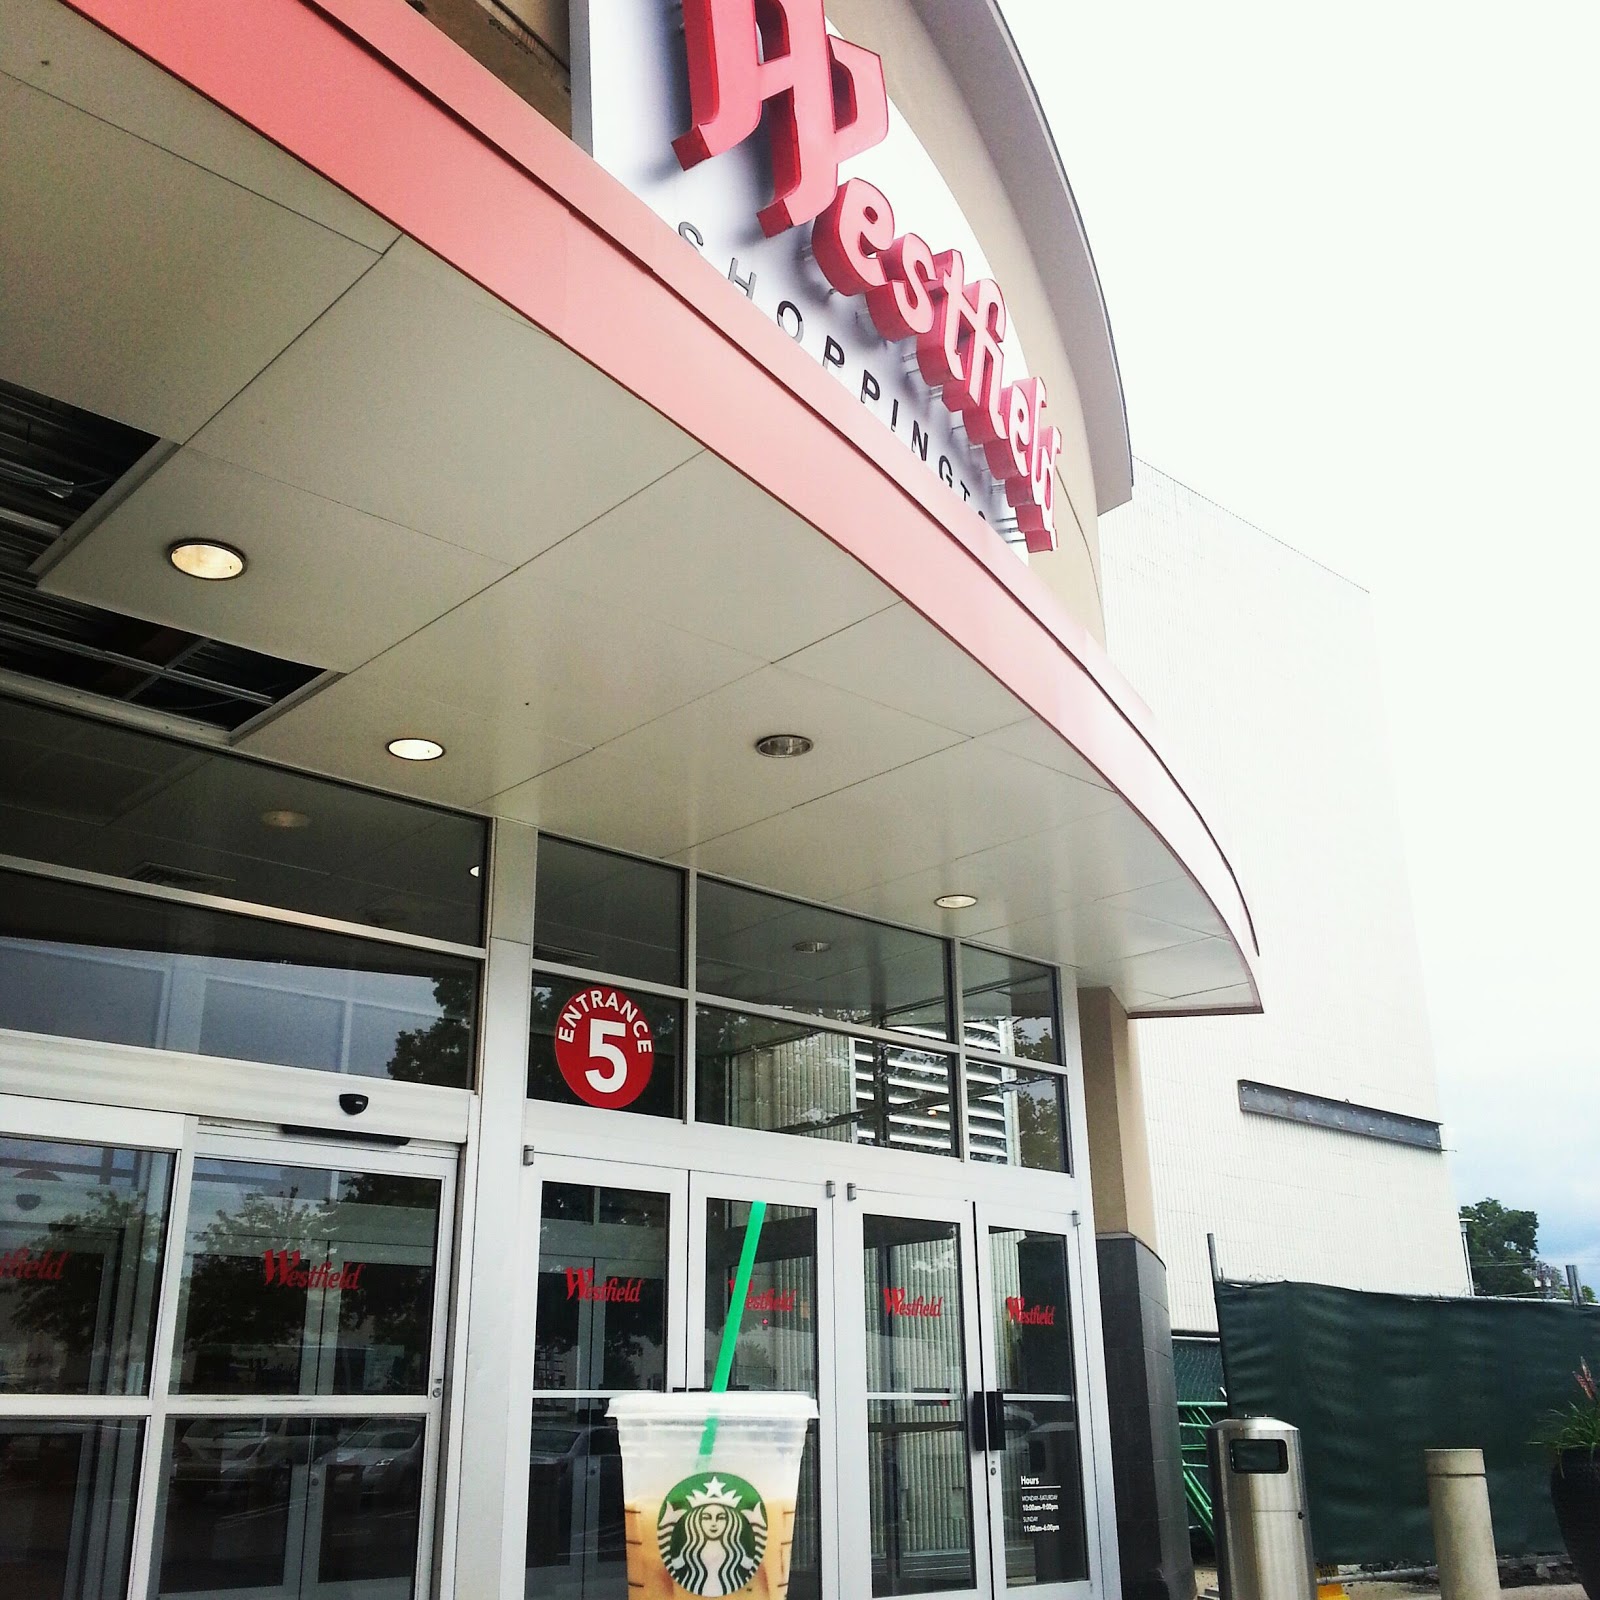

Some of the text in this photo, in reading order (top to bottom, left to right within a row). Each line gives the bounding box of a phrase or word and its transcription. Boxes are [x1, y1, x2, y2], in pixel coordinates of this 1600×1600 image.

[557, 989, 653, 1054] ENTRANCE
[584, 1018, 628, 1094] 5
[261, 1249, 365, 1291] Westfield
[564, 1266, 643, 1303] Westfield
[882, 1287, 943, 1317] Westfield
[1005, 1296, 1056, 1325] Westfield
[1020, 1475, 1040, 1485] Hours
